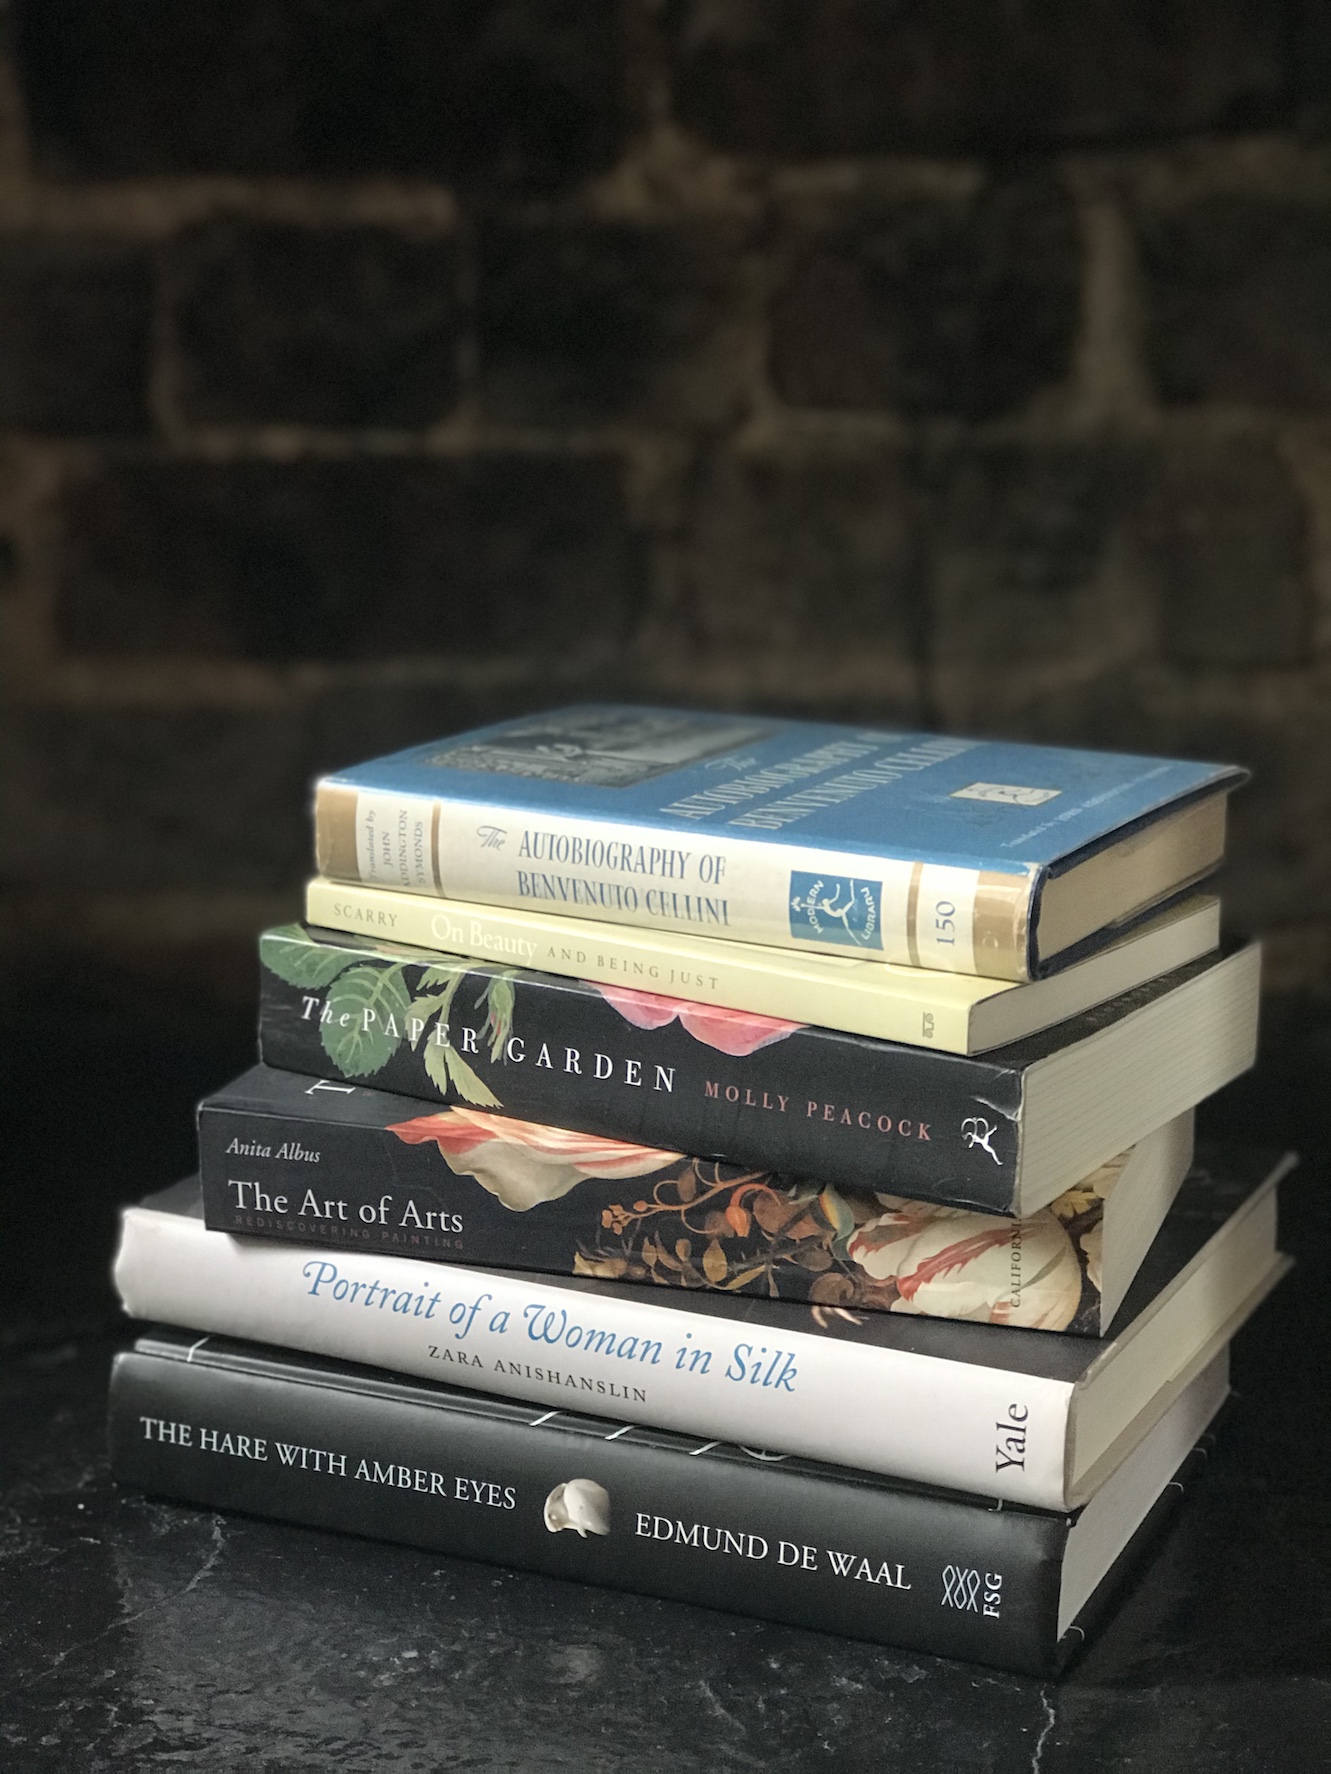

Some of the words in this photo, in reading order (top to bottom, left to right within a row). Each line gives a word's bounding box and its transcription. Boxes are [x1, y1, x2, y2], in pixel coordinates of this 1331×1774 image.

[365, 809, 377, 823] by
[726, 769, 903, 830] BENVENUTO
[365, 825, 378, 880] Translated
[382, 831, 394, 868] JOHN
[414, 820, 426, 884] SYMONDS
[476, 825, 507, 850] The
[517, 830, 692, 879] AUTOBIOGRAPHY
[699, 854, 727, 885] OF
[516, 870, 639, 912] BENVENUTO
[645, 888, 732, 926] CELLINI
[807, 879, 825, 934] MODERN
[861, 887, 876, 940] LIBRARY
[935, 900, 956, 946] 150
[333, 903, 398, 928] SCARRY
[431, 914, 463, 943] On
[470, 922, 538, 966] Beauty
[547, 946, 587, 964] AND
[597, 955, 660, 978] BEING
[668, 969, 720, 990] JUST
[301, 995, 350, 1028] The
[362, 1007, 479, 1054] PAPER
[507, 1037, 676, 1093] GARDEN
[704, 1081, 789, 1112] MOLLY
[806, 1101, 931, 1141] PEACOCK
[225, 1137, 271, 1158] Anita
[275, 1142, 321, 1163] Albus
[228, 1179, 288, 1214] The
[298, 1189, 349, 1221] Art
[359, 1195, 393, 1225] of
[399, 1200, 464, 1233] Arts
[234, 1215, 371, 1240] REDISCOVERING
[381, 1231, 464, 1250] PAINTING
[1010, 1218, 1022, 1308] CALIFORNI
[303, 1260, 443, 1320] Portrait
[448, 1293, 493, 1340] of
[488, 1313, 509, 1335] a
[524, 1303, 662, 1366] Woman
[674, 1332, 712, 1375] in
[725, 1342, 800, 1393] Silk
[428, 1344, 483, 1368] ZARA
[494, 1359, 648, 1403] ANISHANSLIN
[139, 1416, 193, 1447] THE
[199, 1427, 268, 1461] HARE
[274, 1442, 348, 1478] WITH
[354, 1459, 448, 1497] AMBER
[454, 1477, 517, 1510] EYES
[996, 1403, 1028, 1473] Yale
[635, 1512, 769, 1560] EDMUND
[777, 1540, 818, 1571] DE
[826, 1549, 912, 1590] WAAL
[983, 1572, 1003, 1619] FSG
